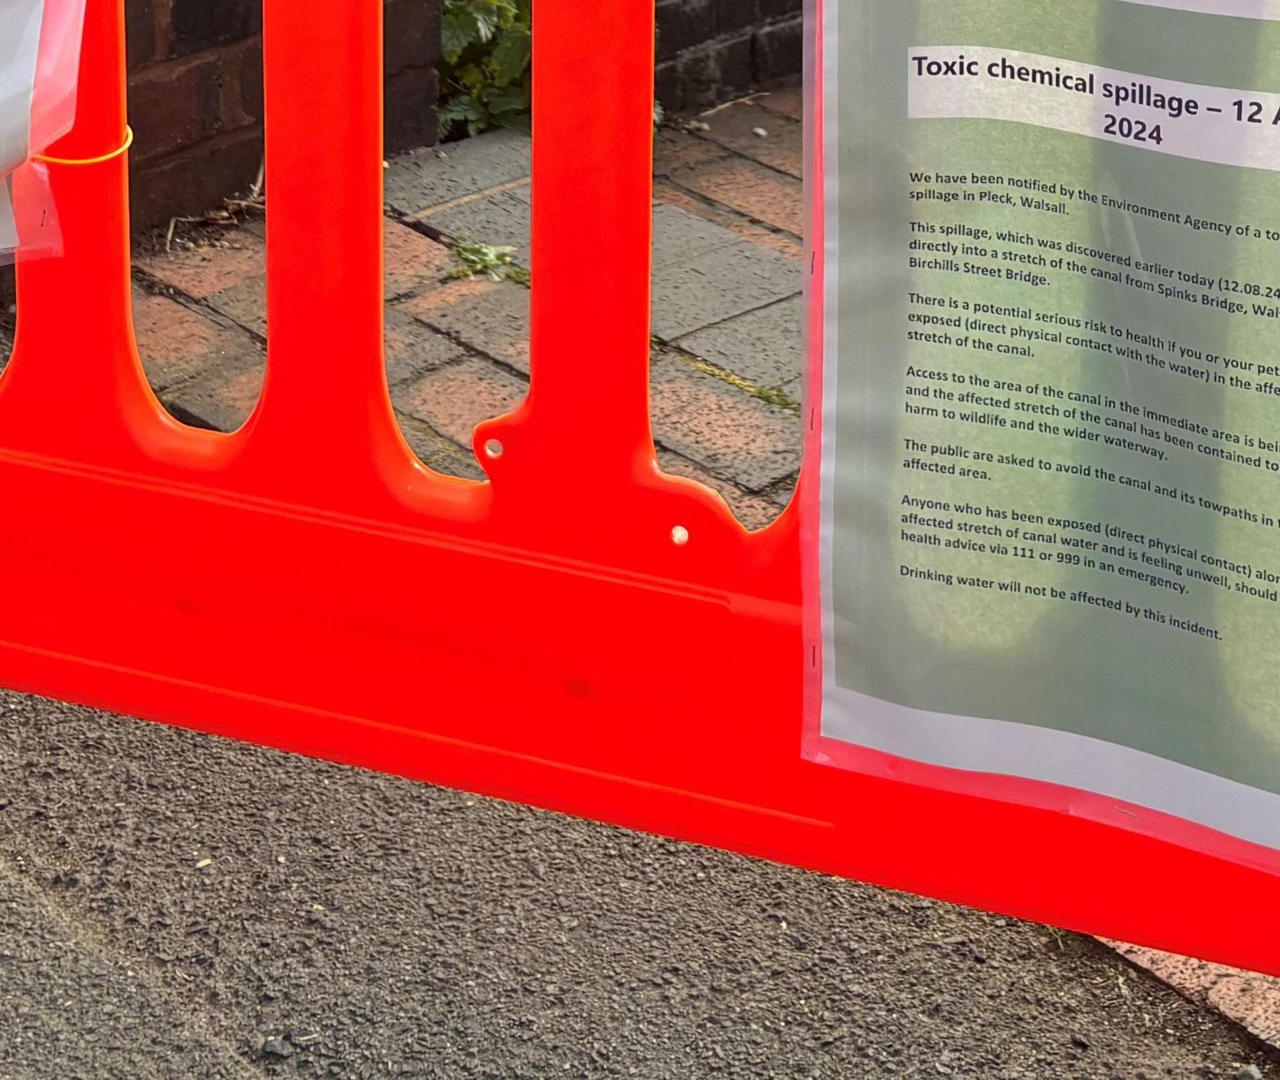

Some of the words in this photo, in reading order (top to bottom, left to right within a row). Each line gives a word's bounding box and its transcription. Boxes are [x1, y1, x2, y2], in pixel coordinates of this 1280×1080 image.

[912, 56, 978, 76] Toxic
[987, 58, 1094, 94] chemical
[1103, 83, 1198, 117] spillage
[1233, 100, 1262, 123] 12
[1103, 114, 1163, 146] 2024
[909, 189, 959, 202] spillage
[963, 190, 975, 201] in
[979, 191, 1016, 207] Pleck,
[1020, 196, 1069, 215] Walsall.
[910, 173, 932, 183] We
[936, 173, 967, 184] have
[971, 173, 1004, 184] been
[1008, 178, 1056, 194] notified
[1060, 184, 1075, 200] by
[1078, 190, 1098, 203] the
[1102, 195, 1180, 223] Environment
[1184, 215, 1232, 235] Agency
[1236, 225, 1250, 236] of
[1254, 229, 1261, 238] a
[909, 222, 936, 233] This
[939, 224, 994, 240] spillage,
[996, 231, 1034, 245] which
[1037, 239, 1063, 251] was
[1066, 242, 1131, 267] discovered
[1135, 262, 1174, 278] earlier
[1178, 271, 1214, 289] today
[909, 257, 960, 272] Birchills
[963, 262, 1002, 278] Street
[1006, 269, 1050, 286] Bridge.
[909, 240, 958, 256] directly
[962, 243, 988, 257] into
[991, 250, 998, 259] a
[1002, 251, 1046, 266] stretch
[1050, 258, 1063, 269] of
[1066, 261, 1087, 274] the
[1091, 268, 1122, 283] canal
[1126, 274, 1154, 291] from
[1158, 284, 1197, 302] Spinks
[1202, 294, 1248, 315] Bridge,
[908, 331, 952, 345] stretch
[955, 336, 969, 347] of
[972, 338, 993, 351] the
[997, 344, 1035, 357] canal.
[908, 314, 961, 327] exposed
[965, 318, 1007, 334] (direct
[1010, 326, 1062, 342] physical
[1066, 337, 1112, 353] contact
[1116, 347, 1142, 361] with
[1145, 354, 1165, 368] the
[1169, 362, 1210, 382] water)
[1214, 372, 1225, 384] in
[1230, 376, 1252, 390] the
[909, 293, 945, 307] There
[949, 297, 959, 309] is
[962, 301, 969, 310] a
[974, 304, 1031, 319] potential
[1035, 313, 1081, 328] serious
[1085, 320, 1107, 334] risk
[1110, 326, 1122, 337] to
[1126, 329, 1164, 349] health
[1168, 341, 1176, 352] if
[1180, 347, 1202, 360] you
[1206, 354, 1220, 364] or
[1223, 358, 1254, 371] your
[907, 366, 948, 381] Access
[952, 373, 965, 384] to
[969, 375, 990, 387] the
[993, 381, 1022, 392] area
[1026, 384, 1039, 395] of
[1043, 386, 1064, 399] the
[1068, 392, 1101, 405] canal
[1105, 396, 1115, 409] in
[1120, 401, 1139, 415] the
[1144, 407, 1208, 435] immediate
[1212, 430, 1240, 444] area
[1244, 435, 1254, 447] is
[904, 439, 927, 452] The
[931, 445, 970, 458] public
[973, 452, 994, 462] are
[997, 454, 1035, 468] asked
[1038, 459, 1052, 470] to
[1056, 464, 1091, 476] avoid
[1095, 468, 1115, 482] the
[1119, 476, 1151, 491] canal
[1154, 486, 1177, 498] and
[1181, 491, 1195, 504] its
[1199, 498, 1258, 522] towpaths
[1262, 514, 1274, 527] in
[901, 530, 941, 546] health
[945, 538, 986, 552] advice
[989, 544, 1008, 555] via
[1013, 546, 1035, 559] 111
[1039, 552, 1053, 560] or
[1057, 552, 1080, 565] 999
[1084, 556, 1095, 568] in
[1099, 562, 1114, 572] an
[1118, 567, 1189, 594] emergency.
[900, 566, 953, 585] Drinking
[957, 576, 995, 588] water
[998, 581, 1021, 592] will
[1025, 586, 1047, 596] not
[1051, 587, 1066, 599] be
[1070, 592, 1122, 610] affected
[1126, 602, 1140, 618] by
[1144, 609, 1166, 623] this
[1170, 615, 1222, 640] incident.
